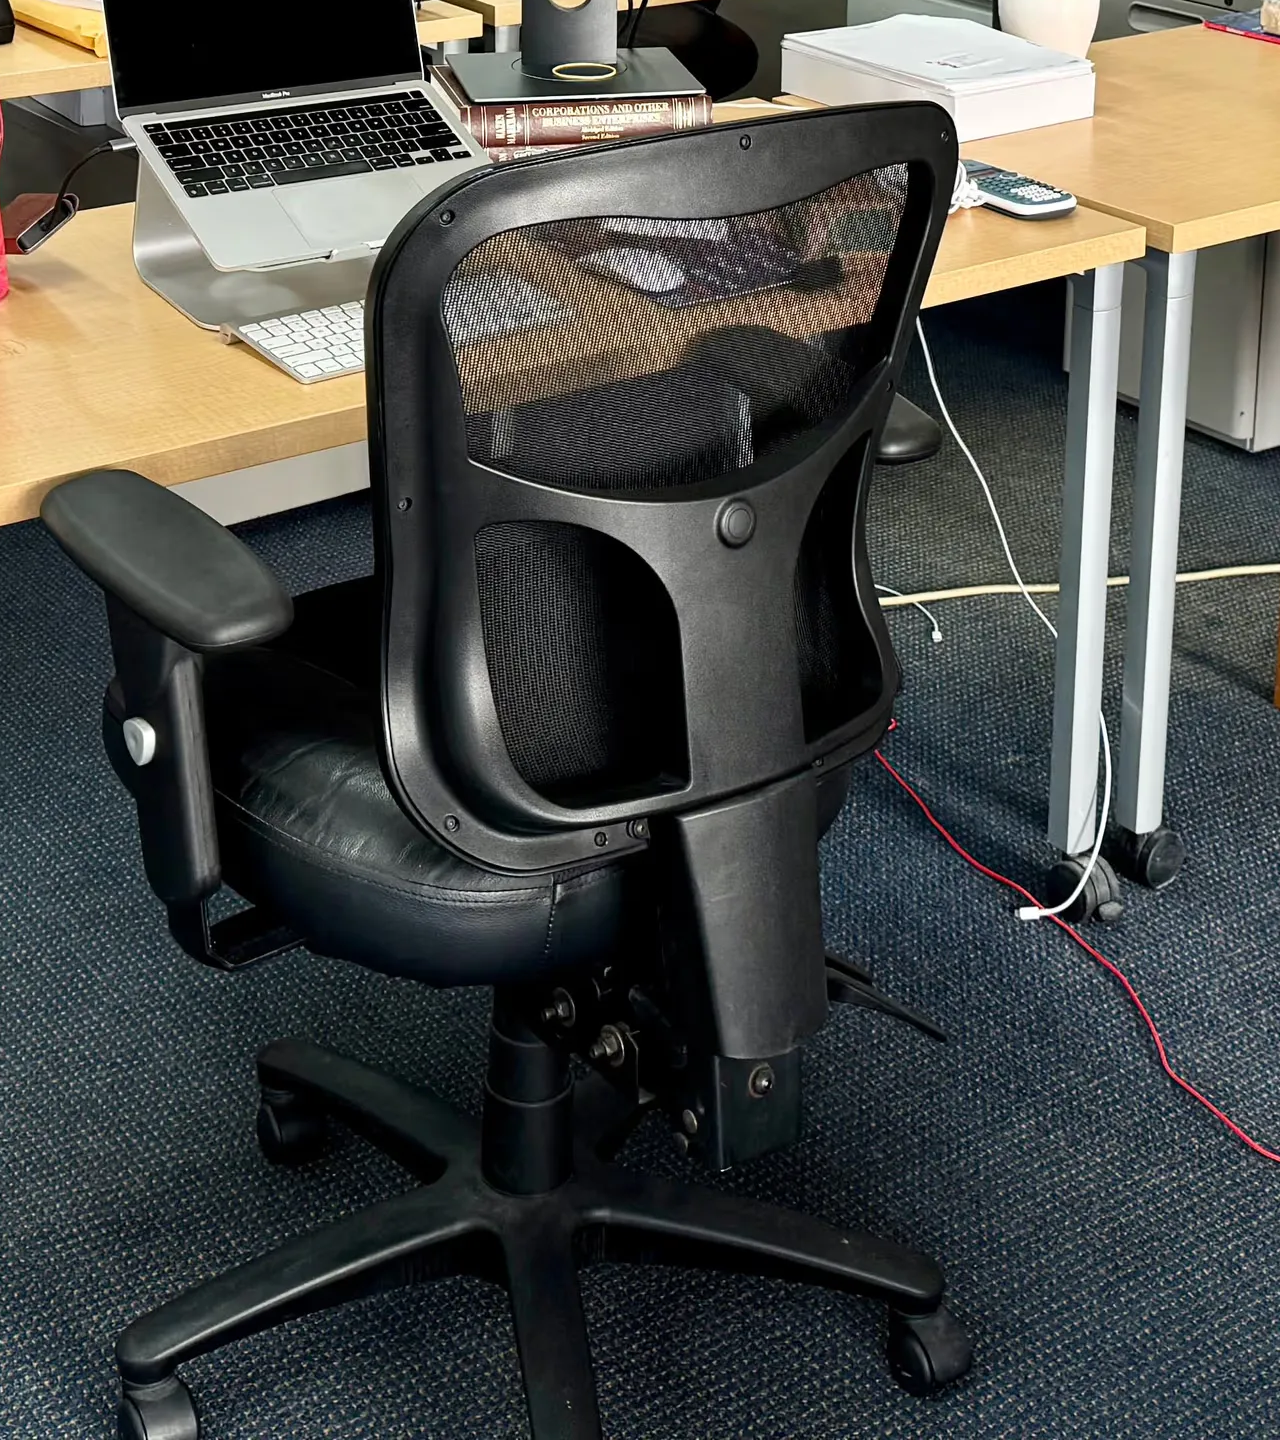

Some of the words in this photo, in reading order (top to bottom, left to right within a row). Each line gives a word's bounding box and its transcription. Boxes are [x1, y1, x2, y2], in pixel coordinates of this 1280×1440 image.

[531, 105, 610, 117] CORPORATIONS
[611, 103, 634, 115] AND
[634, 101, 671, 113] OTHER
[542, 116, 593, 128] BUSINESS
